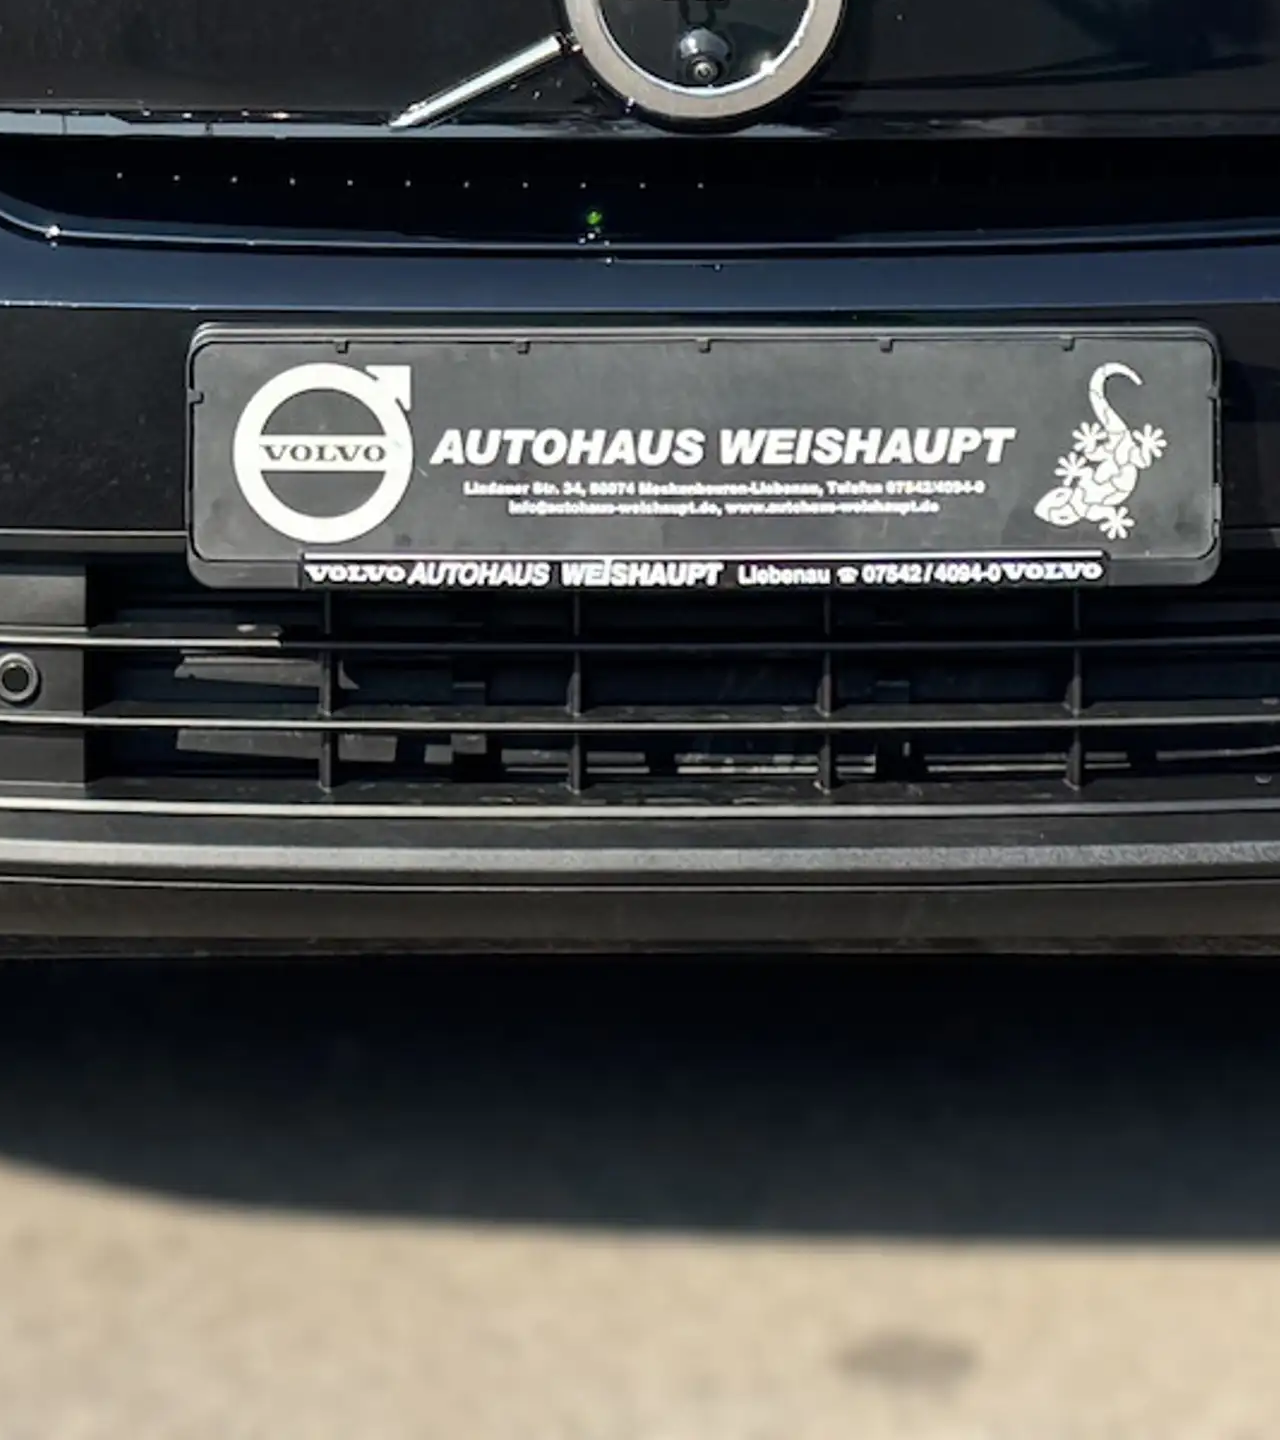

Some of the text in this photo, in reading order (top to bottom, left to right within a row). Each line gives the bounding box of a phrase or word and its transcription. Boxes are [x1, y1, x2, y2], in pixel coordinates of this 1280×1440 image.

[260, 444, 387, 462] VOLVO
[429, 427, 1016, 465] AUTOHAUS WEISHAUPT
[304, 564, 406, 583] VOLVO
[407, 562, 550, 587] AUTOHAUS
[562, 561, 725, 587] WEISHAUPT
[738, 564, 832, 586] Liebenau
[1001, 561, 1104, 580] VOLVO
